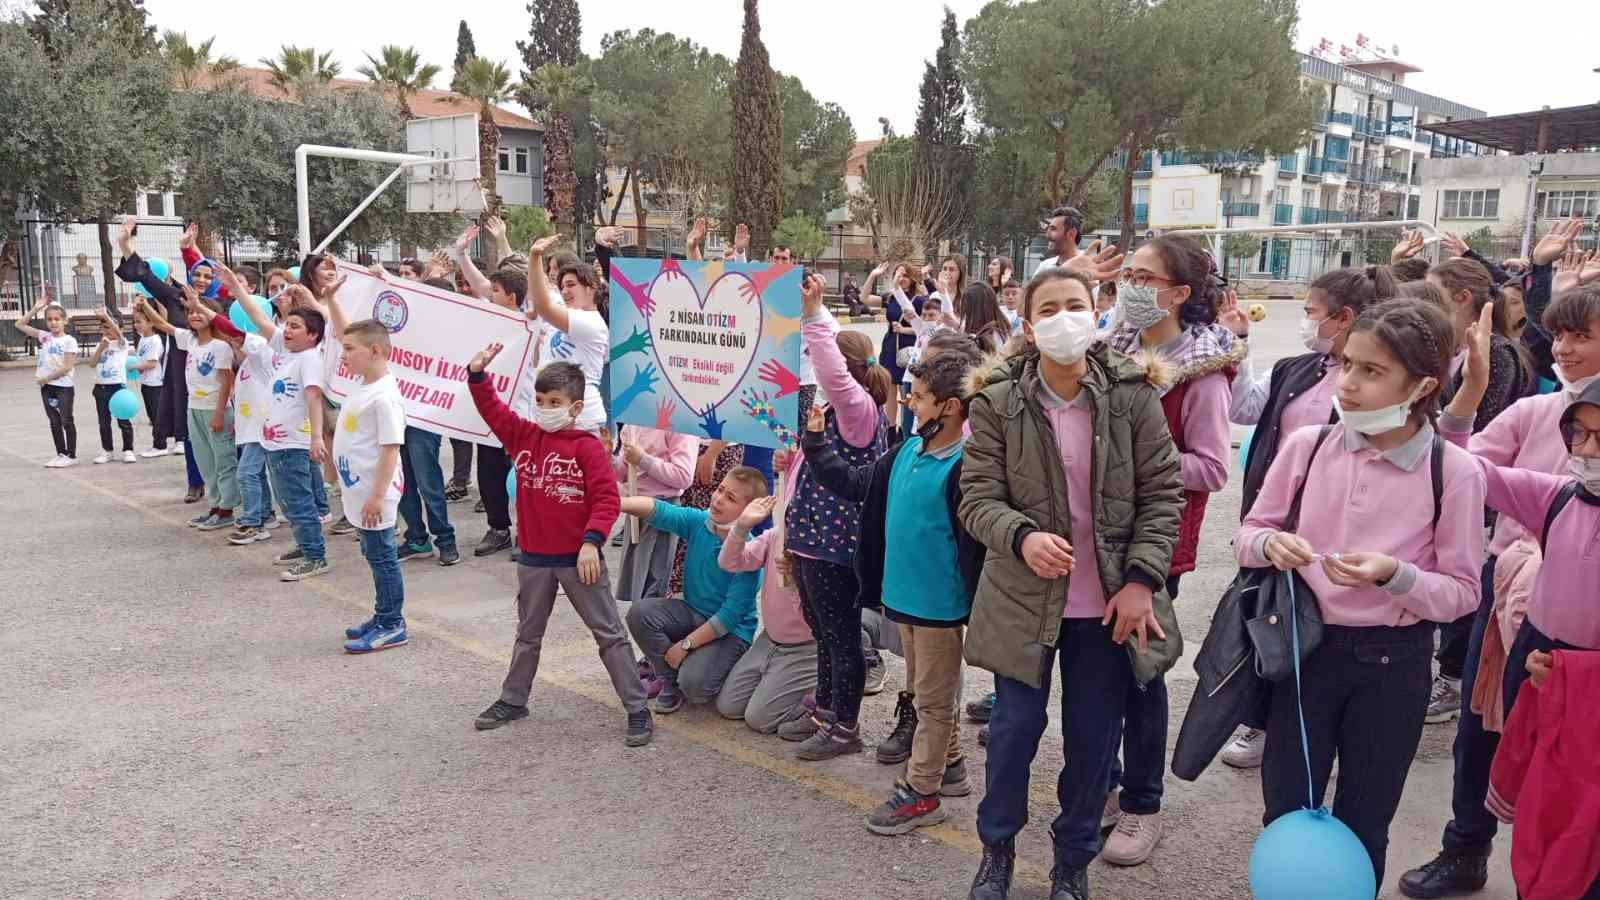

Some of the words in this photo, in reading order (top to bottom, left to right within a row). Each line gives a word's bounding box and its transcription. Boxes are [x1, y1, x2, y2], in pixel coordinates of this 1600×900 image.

[669, 310, 675, 323] 2
[678, 309, 705, 326] NİSAN
[707, 312, 736, 329] OTİZM
[660, 327, 717, 345] FARKINDALIK
[719, 332, 746, 349] GÜNÜ
